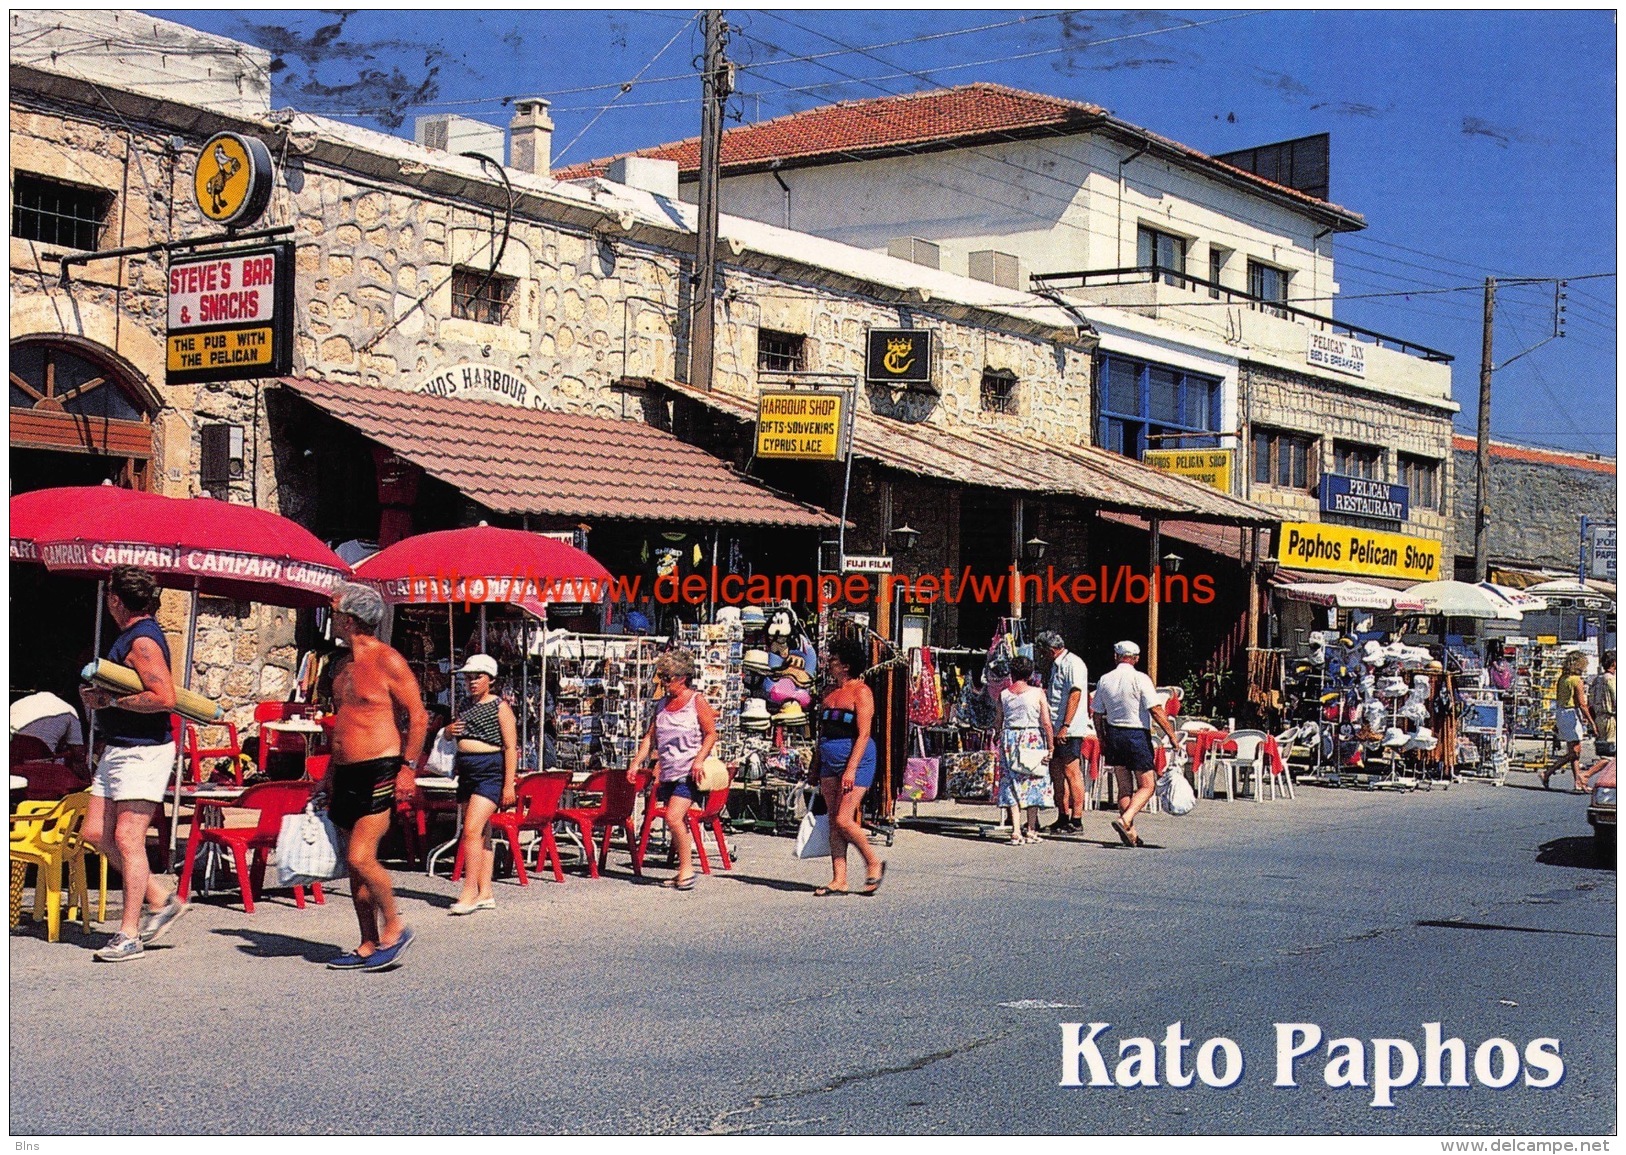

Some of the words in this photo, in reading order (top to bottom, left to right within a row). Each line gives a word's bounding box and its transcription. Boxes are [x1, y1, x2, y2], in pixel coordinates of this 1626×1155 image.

[170, 262, 231, 295] STEVE'S
[242, 257, 273, 287] BAR
[180, 305, 192, 324] &
[174, 338, 195, 352] THE
[204, 335, 226, 349] PUB
[237, 332, 265, 346] WITH
[181, 353, 202, 367] THE
[210, 348, 258, 365] PELICAN
[1310, 349, 1323, 362] BED
[1330, 354, 1364, 373] BREAKFAST
[1351, 345, 1364, 360] INN
[462, 367, 528, 405] HARBOUR
[762, 398, 807, 415] HARBOUR
[809, 399, 836, 416] SHOP
[763, 438, 797, 452] CYPRUS
[800, 440, 823, 452] LACE
[1176, 455, 1205, 469] PELICAN
[1209, 455, 1227, 468] SHOP
[1350, 479, 1391, 500] PELICAN
[1335, 493, 1403, 519] RESTAURANT
[43, 545, 88, 565] CAMPARI
[91, 543, 182, 567] CAMPARI
[187, 551, 284, 580] CAMPARI
[1288, 529, 1342, 562] Paphos
[1350, 537, 1398, 567] Pelican
[1404, 544, 1434, 575] Shop
[846, 559, 867, 568] FUJI
[869, 560, 891, 568] FILM
